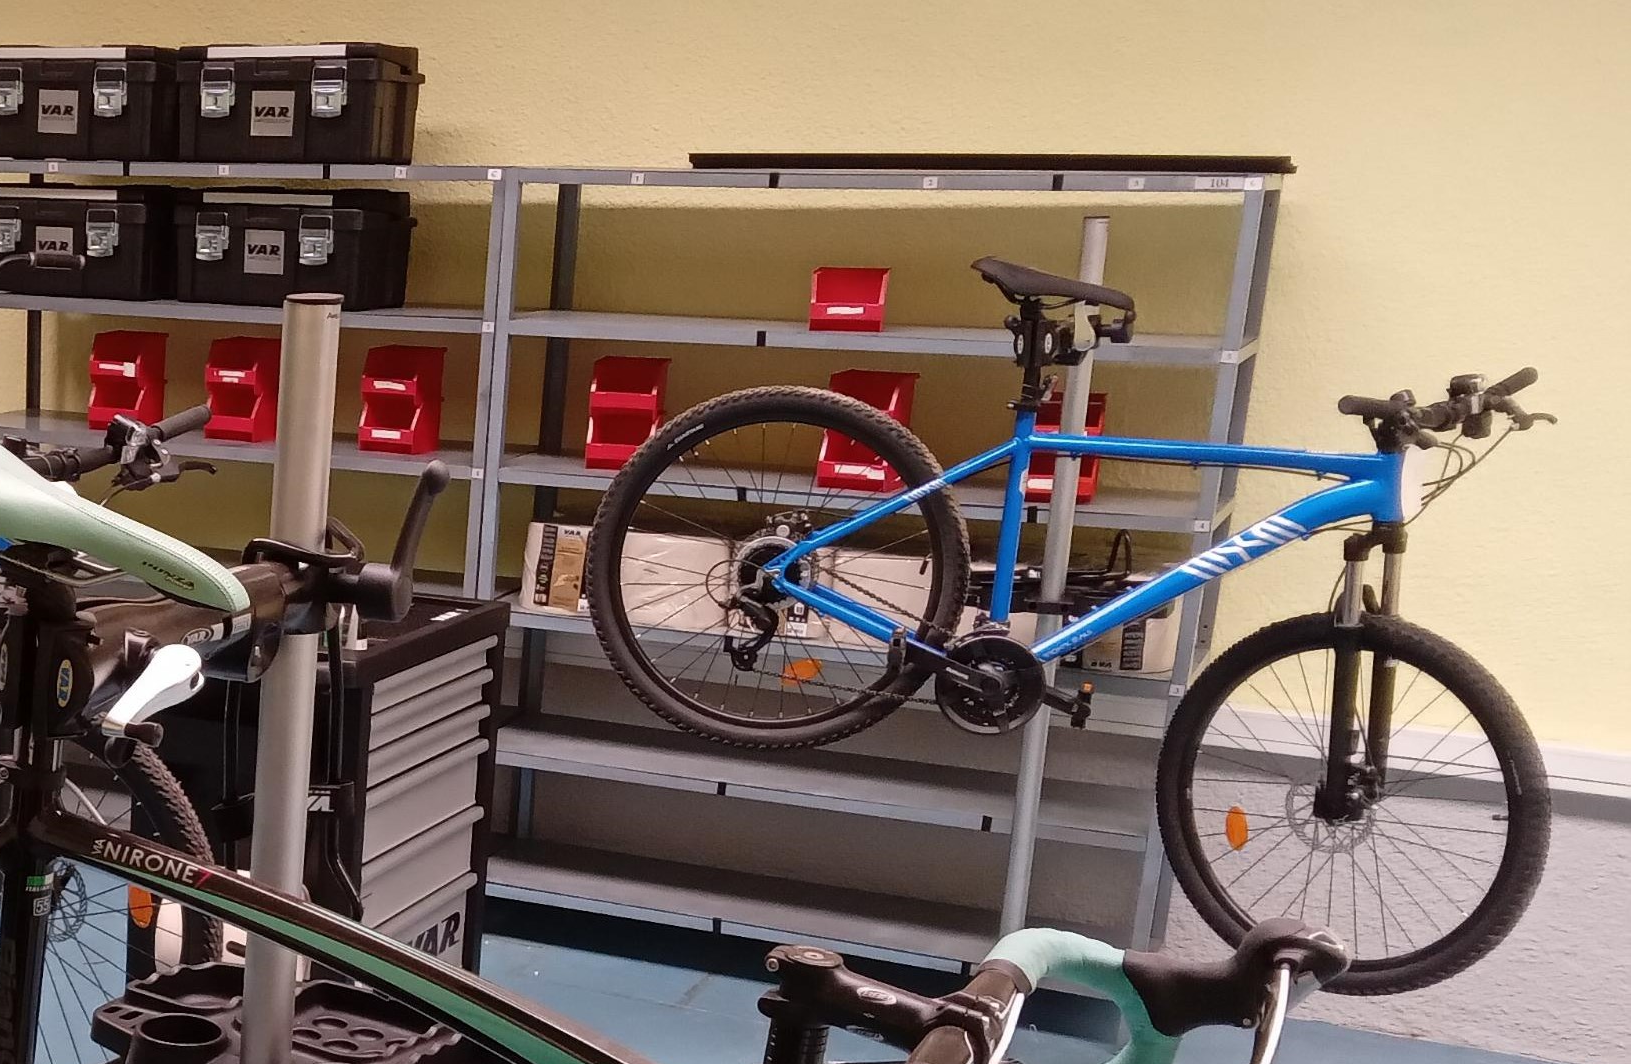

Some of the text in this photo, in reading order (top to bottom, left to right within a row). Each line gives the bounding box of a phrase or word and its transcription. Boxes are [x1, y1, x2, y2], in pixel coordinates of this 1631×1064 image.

[41, 104, 74, 116] VAR
[254, 106, 289, 118] VAR
[38, 239, 69, 252] VAR
[247, 243, 281, 256] VAR
[91, 838, 107, 855] VIA
